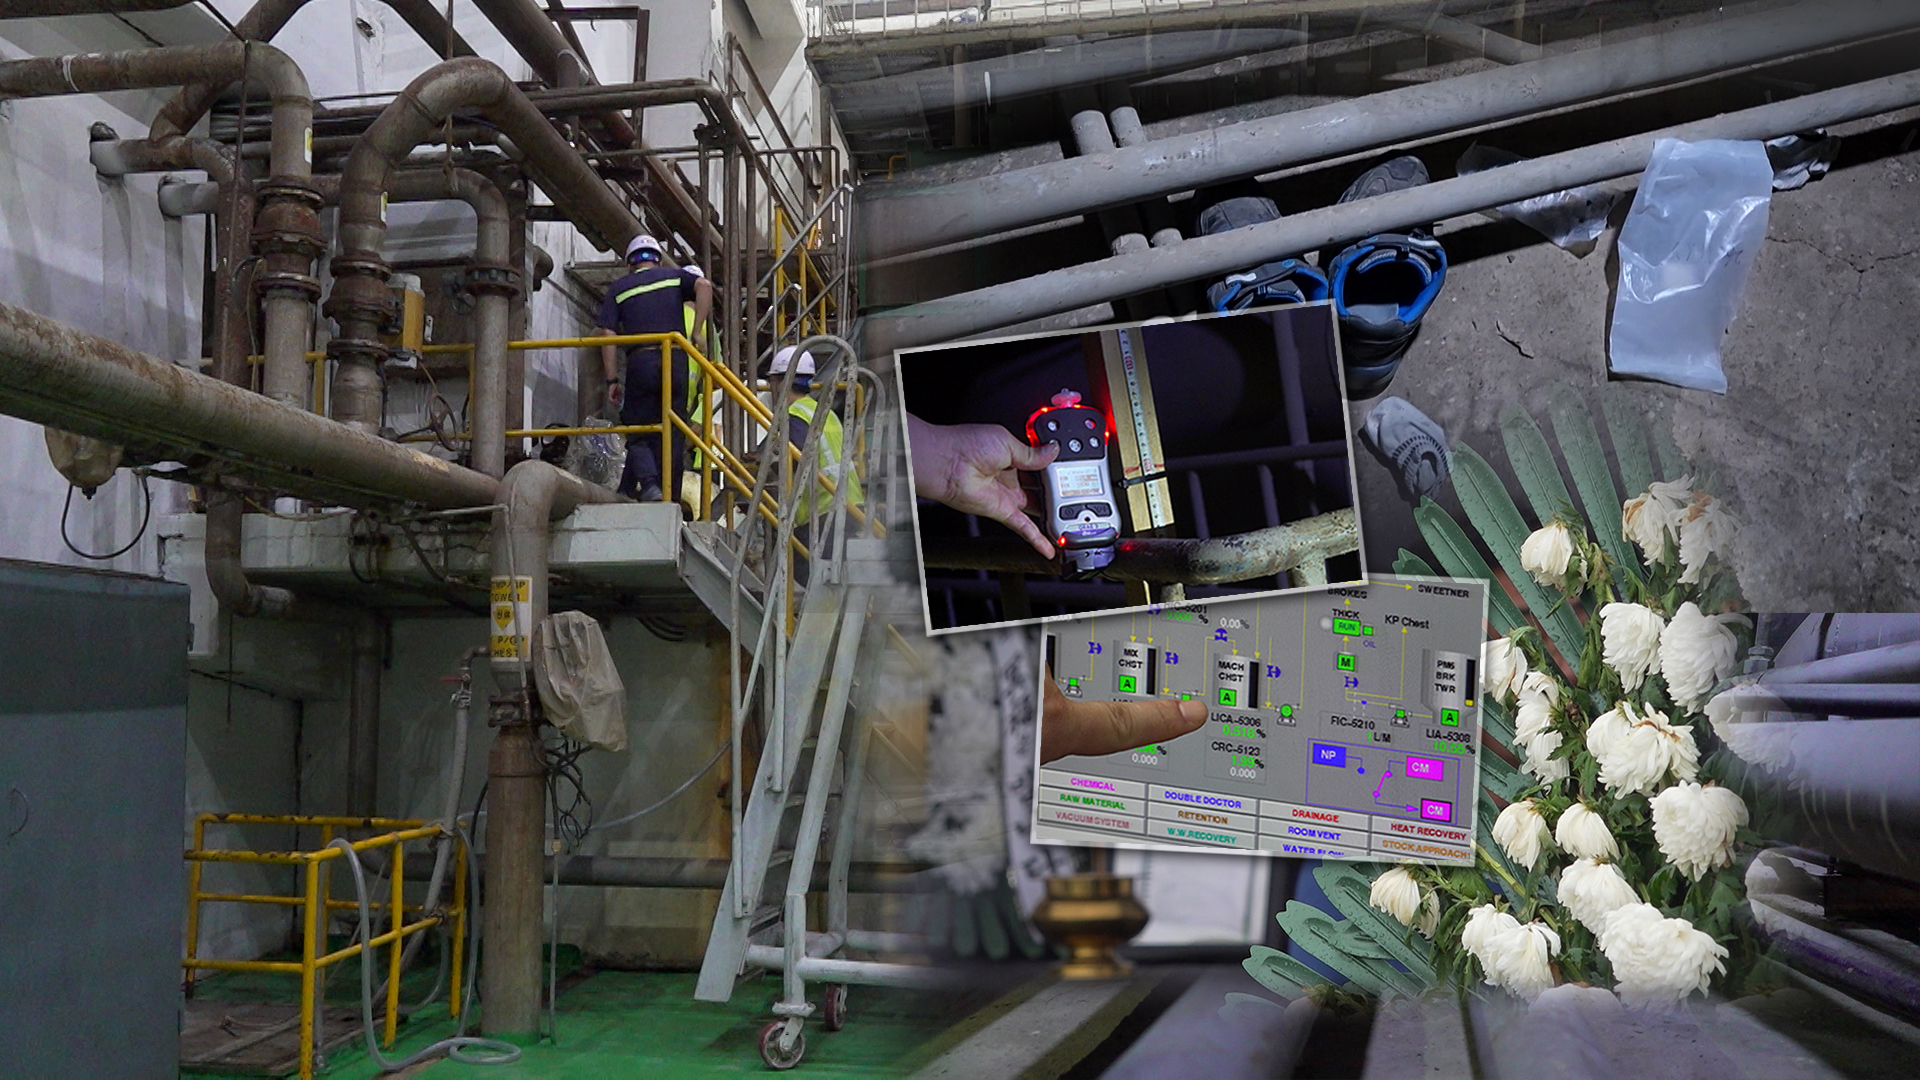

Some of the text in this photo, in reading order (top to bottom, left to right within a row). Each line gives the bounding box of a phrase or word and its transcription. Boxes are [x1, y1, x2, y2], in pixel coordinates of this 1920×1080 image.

[1327, 587, 1368, 600] BROKES
[1417, 584, 1470, 598] SWEETNER
[1332, 608, 1360, 620] THICK
[1338, 622, 1356, 631] RUN
[1384, 614, 1430, 629] KP Chest
[1363, 639, 1377, 649] OIL
[1123, 648, 1139, 658] MIX
[1118, 658, 1144, 669] CHST
[1218, 660, 1245, 672] MACH
[1341, 657, 1350, 668] M
[1218, 672, 1244, 683] CHST
[1436, 671, 1456, 682] BRK
[1123, 679, 1131, 689] A
[1434, 683, 1456, 693] TWR
[1223, 692, 1231, 702] A
[1330, 715, 1375, 730] FIC-5210
[1446, 712, 1454, 723] A
[1211, 741, 1261, 756] CRC-5123
[1321, 749, 1336, 759] NP
[1131, 753, 1158, 766] 0.000
[1230, 766, 1256, 779] 0.000
[1411, 762, 1429, 773] CM
[1070, 777, 1115, 791] CHEMICAL
[1060, 793, 1126, 810] RAW MATERIAL
[1164, 790, 1242, 809] DOUBLE DOCTOR
[1292, 809, 1339, 823] DRAINAGE
[1427, 805, 1443, 816] CM
[1055, 811, 1130, 829] VACUUM SYSTEM
[1178, 810, 1228, 824] RETENTION
[1287, 826, 1341, 840] ROOM VENT
[1390, 823, 1467, 840] HEAT RECOVERY
[1382, 839, 1415, 852] STOCK
[1415, 845, 1467, 859] APPROACH
